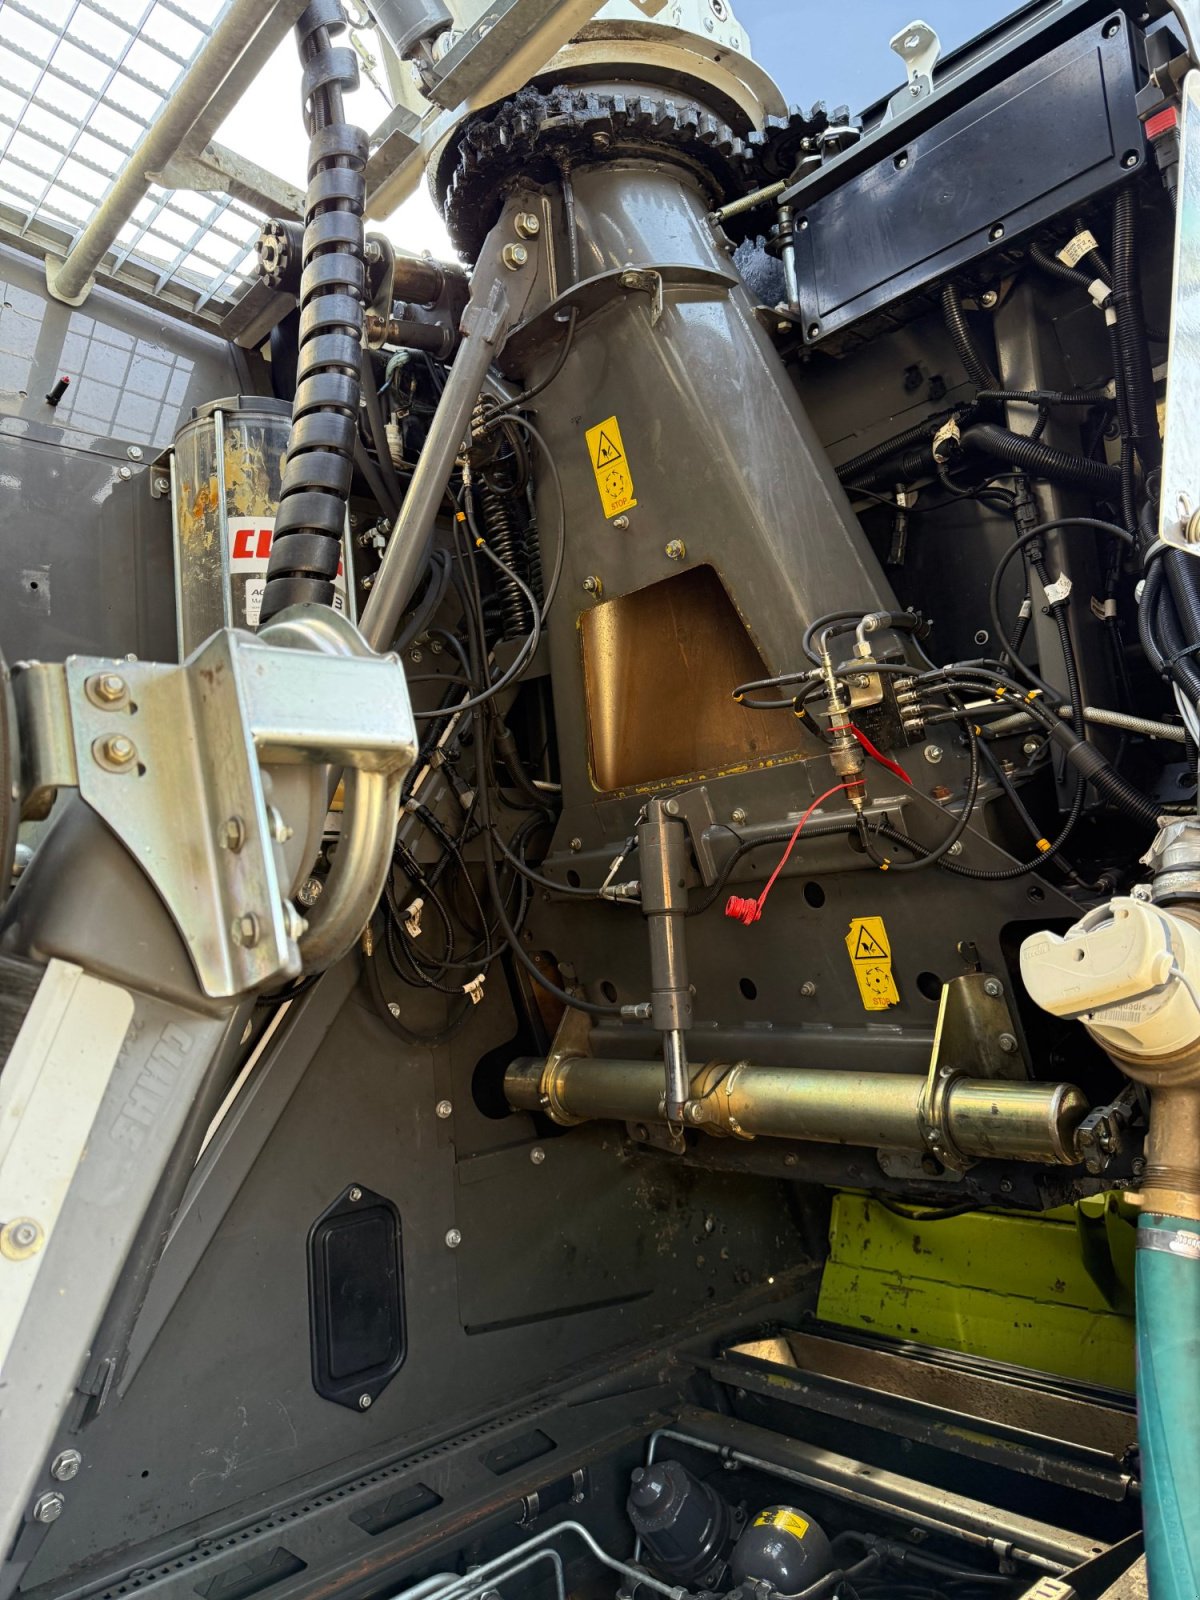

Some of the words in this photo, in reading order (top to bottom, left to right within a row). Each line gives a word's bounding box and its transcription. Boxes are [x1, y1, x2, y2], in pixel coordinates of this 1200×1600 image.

[611, 497, 627, 511] STOP
[872, 996, 890, 1006] STOP
[108, 1021, 195, 1153] CLAAS
